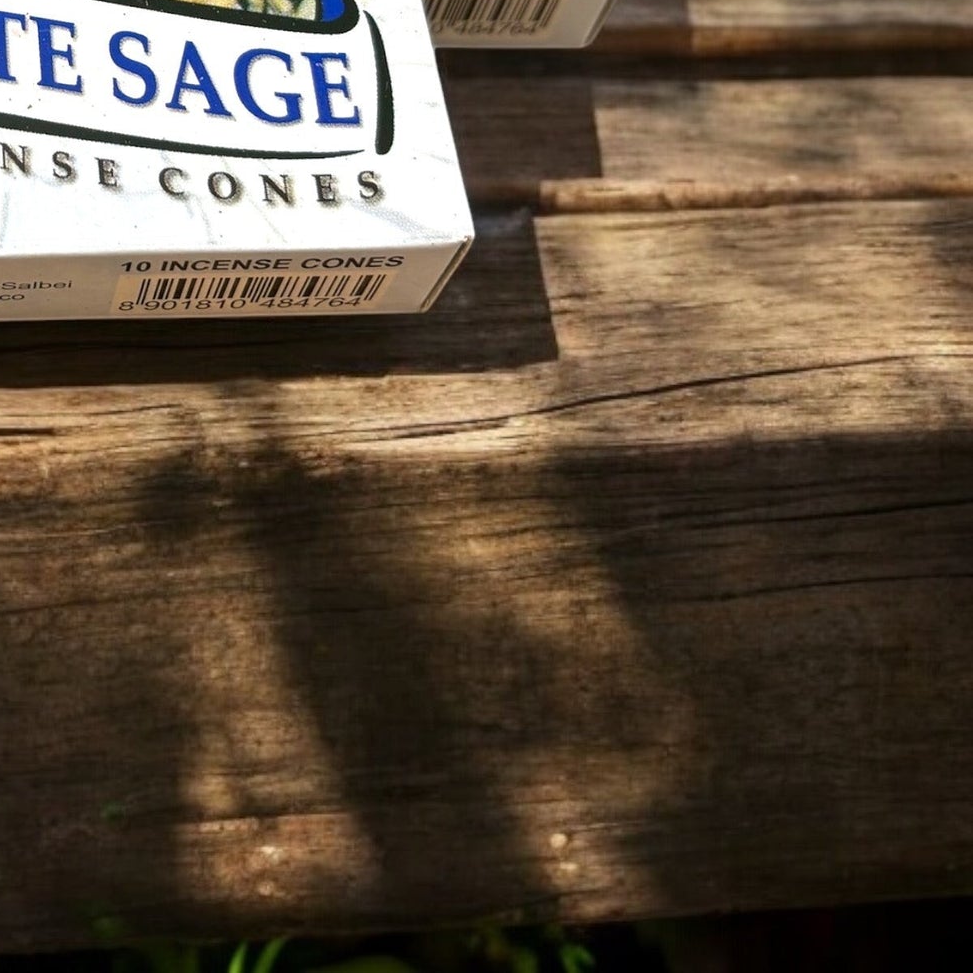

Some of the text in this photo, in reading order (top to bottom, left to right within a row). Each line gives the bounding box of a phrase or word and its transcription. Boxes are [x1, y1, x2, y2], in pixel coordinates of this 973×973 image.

[108, 29, 363, 127] SAGE
[158, 169, 386, 207] CONES
[119, 255, 406, 273] 10 INCENSE CONES
[0, 279, 73, 291] Salbei
[117, 297, 362, 312] 8 901810 484764
